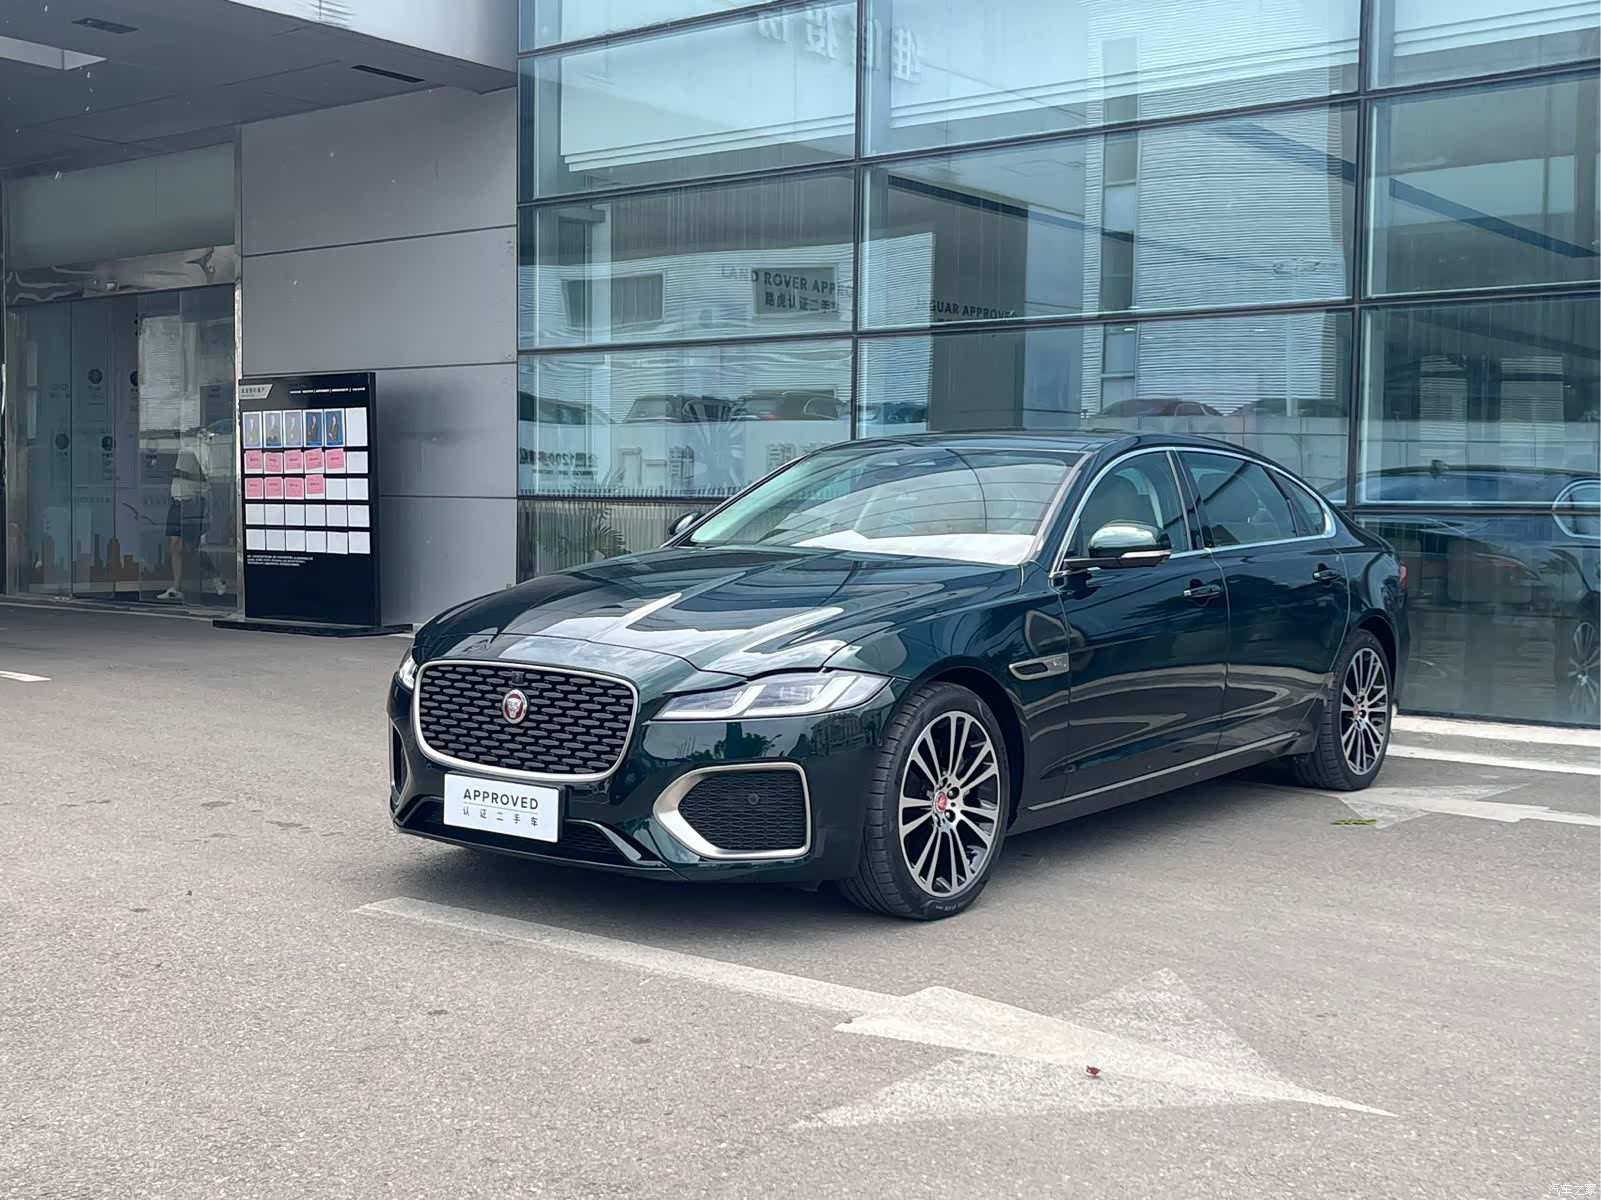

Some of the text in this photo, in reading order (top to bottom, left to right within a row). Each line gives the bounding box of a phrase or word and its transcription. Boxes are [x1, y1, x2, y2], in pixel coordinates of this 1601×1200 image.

[764, 271, 808, 290] ROVER
[463, 788, 539, 810] APPROVED
[462, 805, 539, 827] 认证二手车
